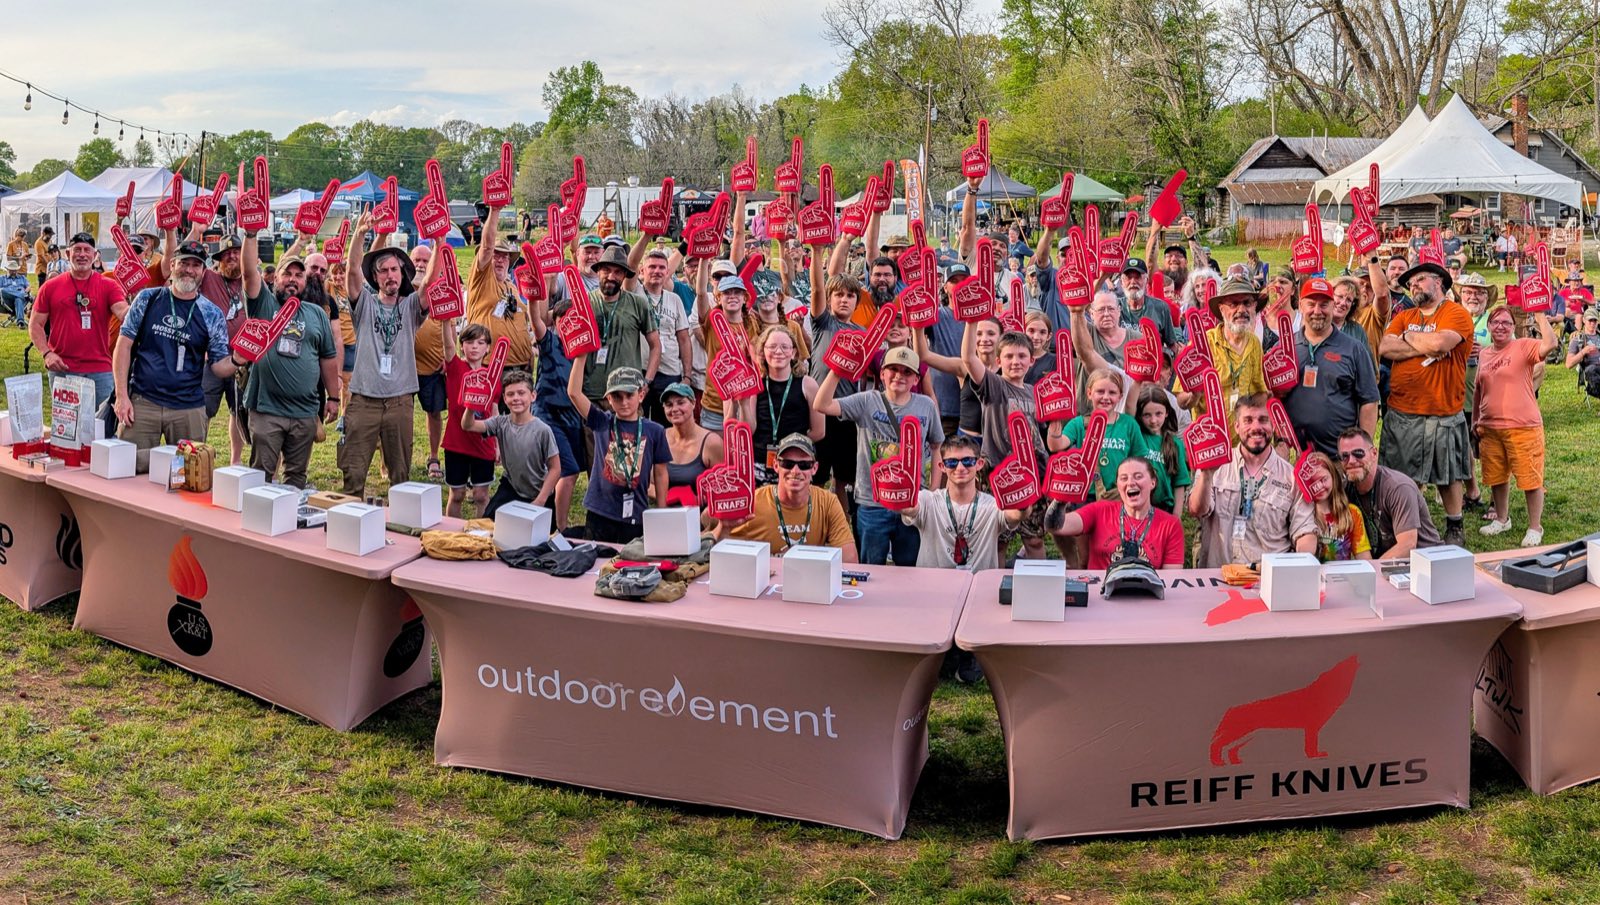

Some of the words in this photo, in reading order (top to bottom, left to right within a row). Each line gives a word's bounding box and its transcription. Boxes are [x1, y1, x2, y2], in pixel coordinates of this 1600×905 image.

[806, 228, 828, 236] KNAFS
[541, 258, 560, 268] KNAFS
[1101, 258, 1120, 266] KNAFS
[1064, 289, 1086, 298] KNAFS
[910, 310, 932, 321] KNAFS
[962, 304, 988, 316] KNAFS
[239, 339, 260, 353] KNAFS
[831, 353, 857, 370] KNAFS
[1272, 372, 1294, 386] KNAFS
[53, 388, 80, 405] HOSS
[1045, 400, 1070, 412] KNAFS
[1198, 446, 1225, 462] KNAFS
[1052, 482, 1081, 492] KNAFS
[880, 490, 908, 500] KNAFS
[1004, 486, 1034, 504] KNAFS
[717, 499, 746, 511] KNAFS
[778, 524, 811, 534] TEAM
[1130, 774, 1255, 808] REIFF
[1272, 758, 1428, 798] KNIVES
